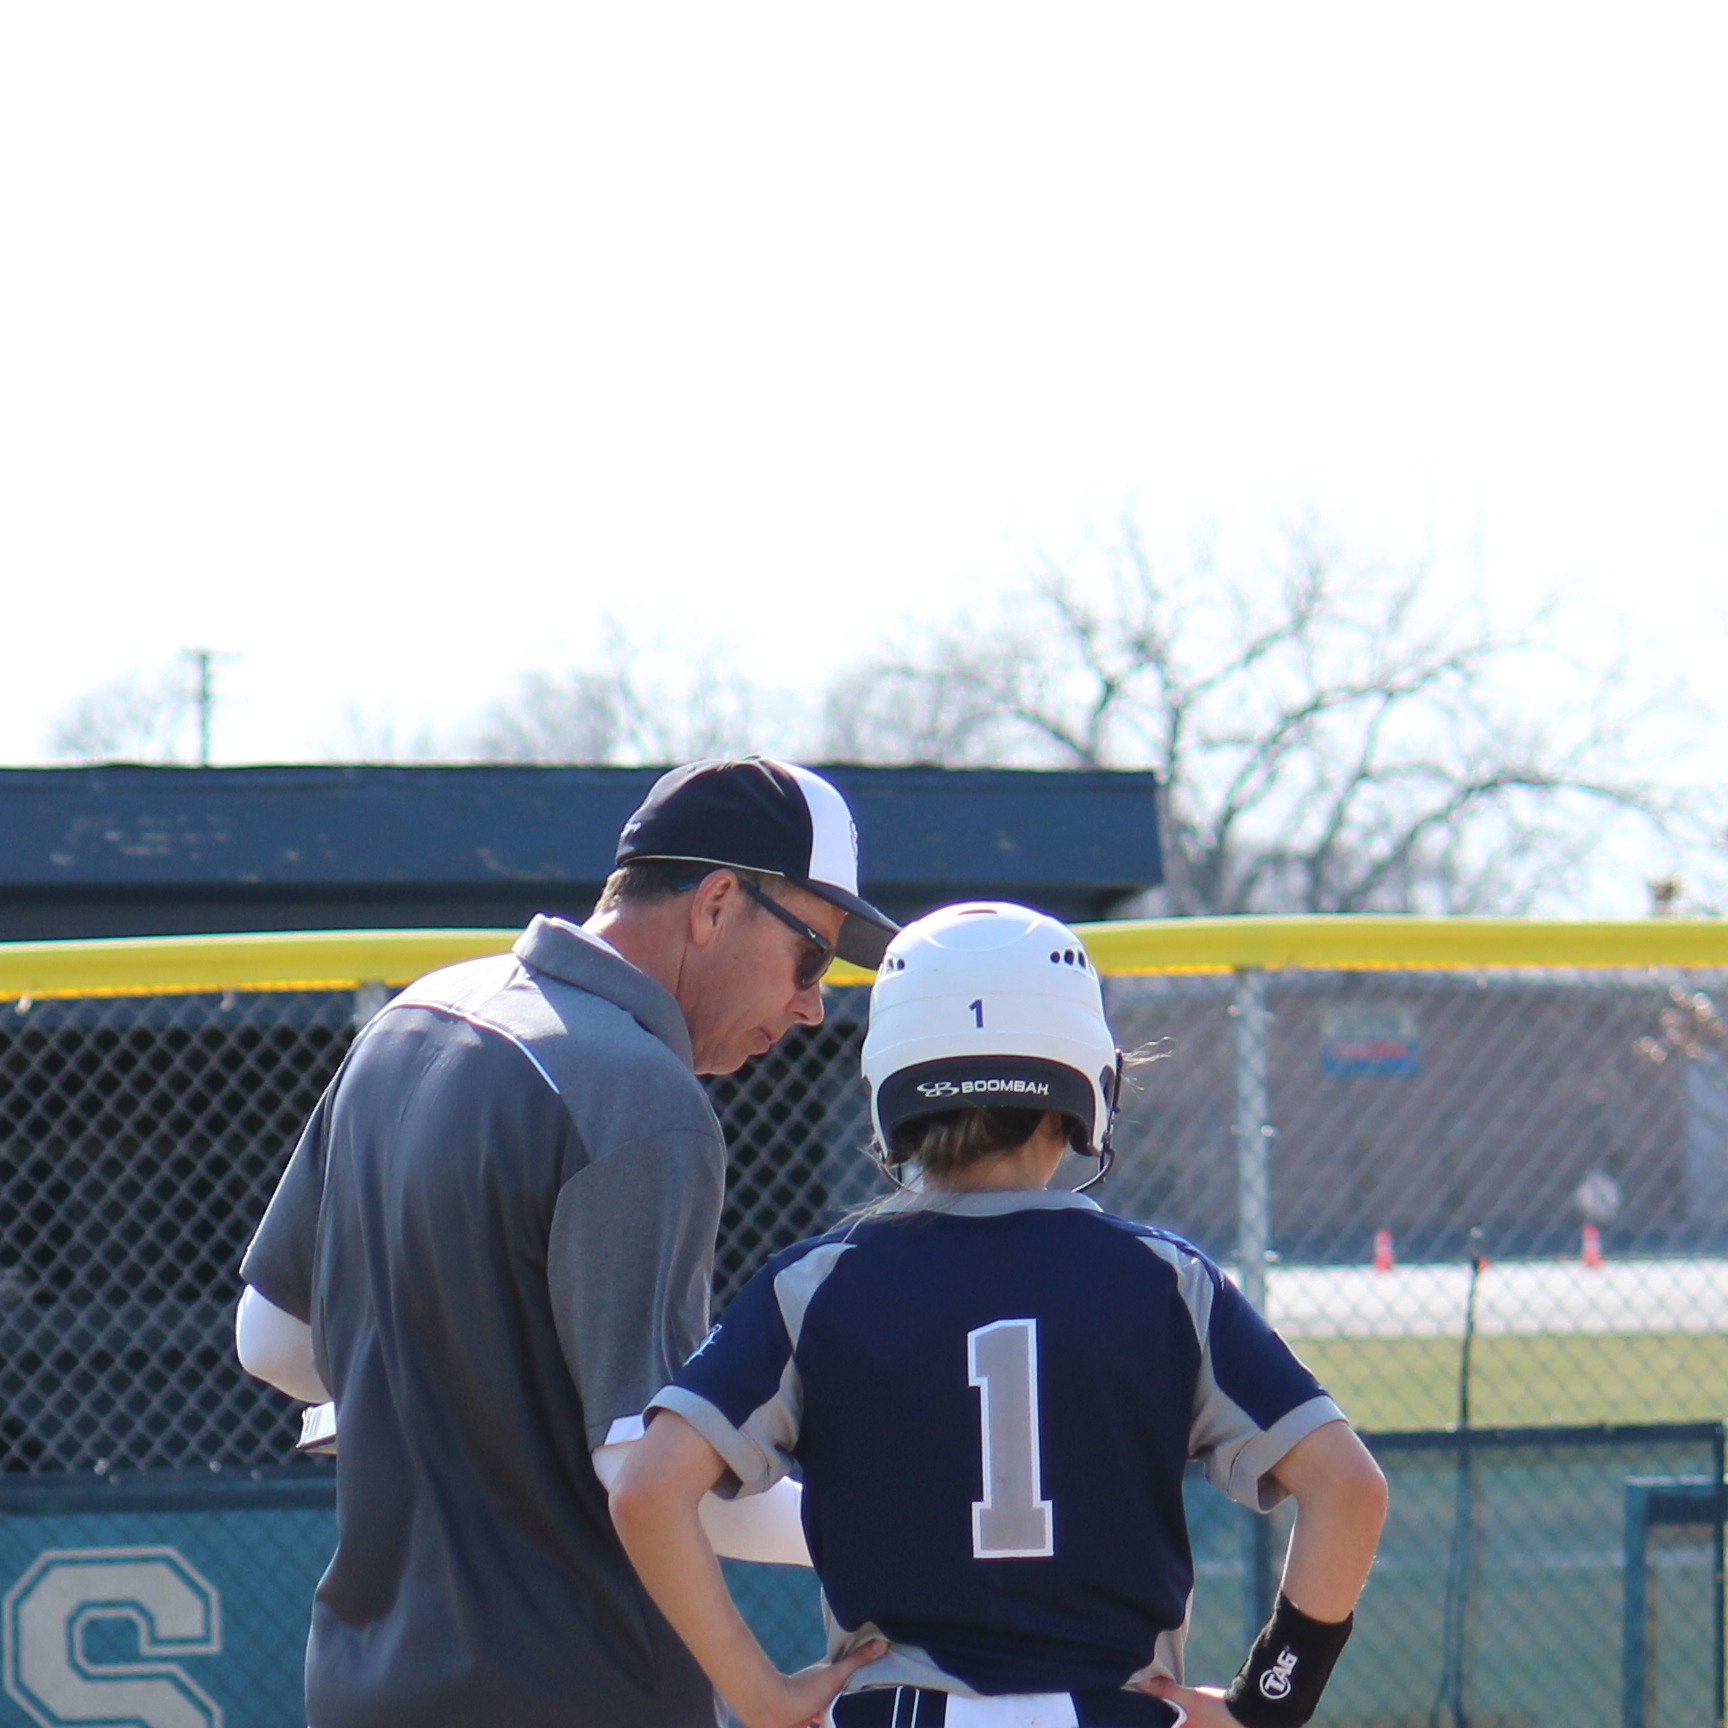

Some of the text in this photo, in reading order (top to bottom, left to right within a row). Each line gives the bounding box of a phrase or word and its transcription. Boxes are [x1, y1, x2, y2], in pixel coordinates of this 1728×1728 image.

[968, 998, 985, 1029] 1
[961, 1079, 1050, 1096] BOOMBAH
[967, 1318, 1054, 1559] 1
[1259, 1649, 1298, 1699] TAG
